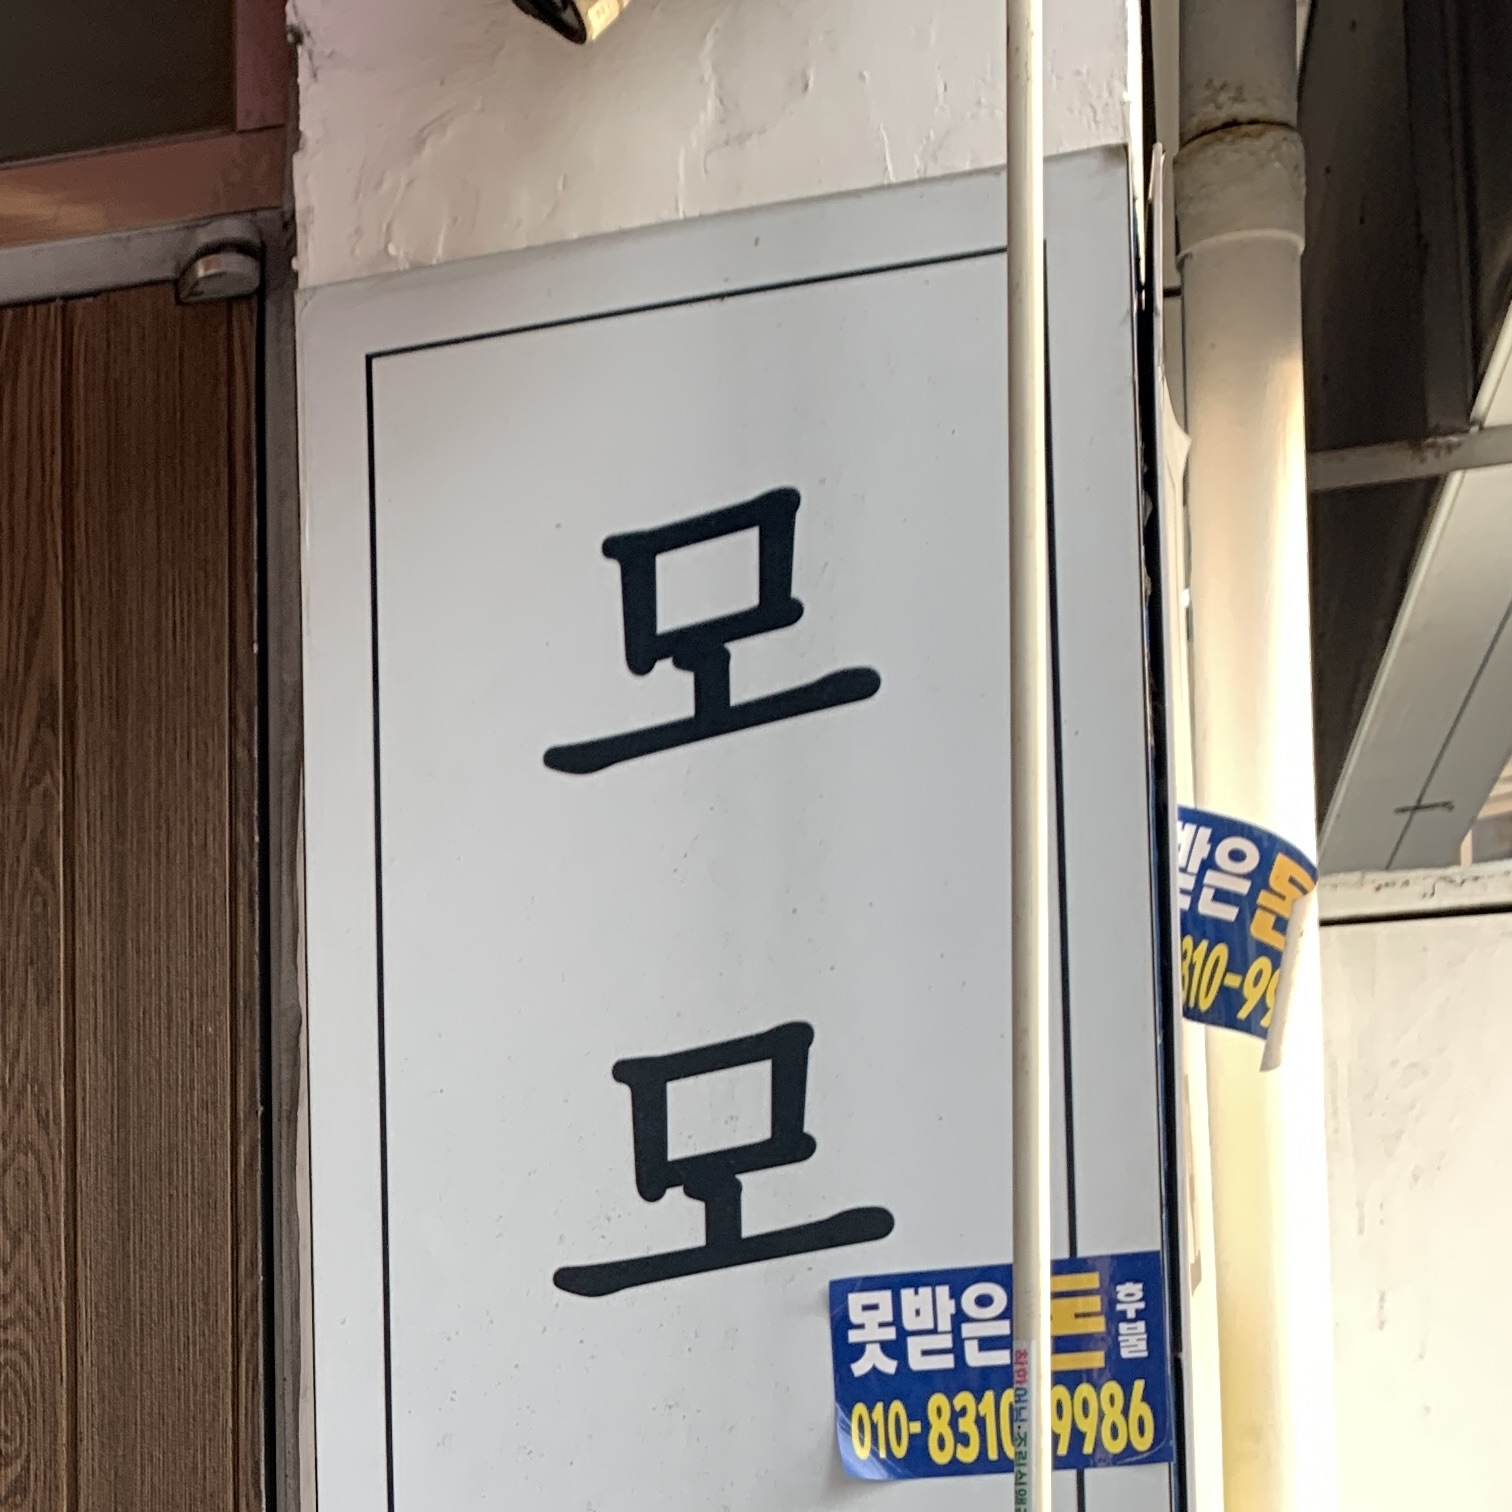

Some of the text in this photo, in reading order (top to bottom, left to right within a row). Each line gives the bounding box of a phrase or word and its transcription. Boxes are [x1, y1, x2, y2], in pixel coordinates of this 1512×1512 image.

[847, 1281, 1012, 1378] 못받은
[1116, 1281, 1148, 1359] 후불
[850, 1379, 1155, 1466] 010-83109986
